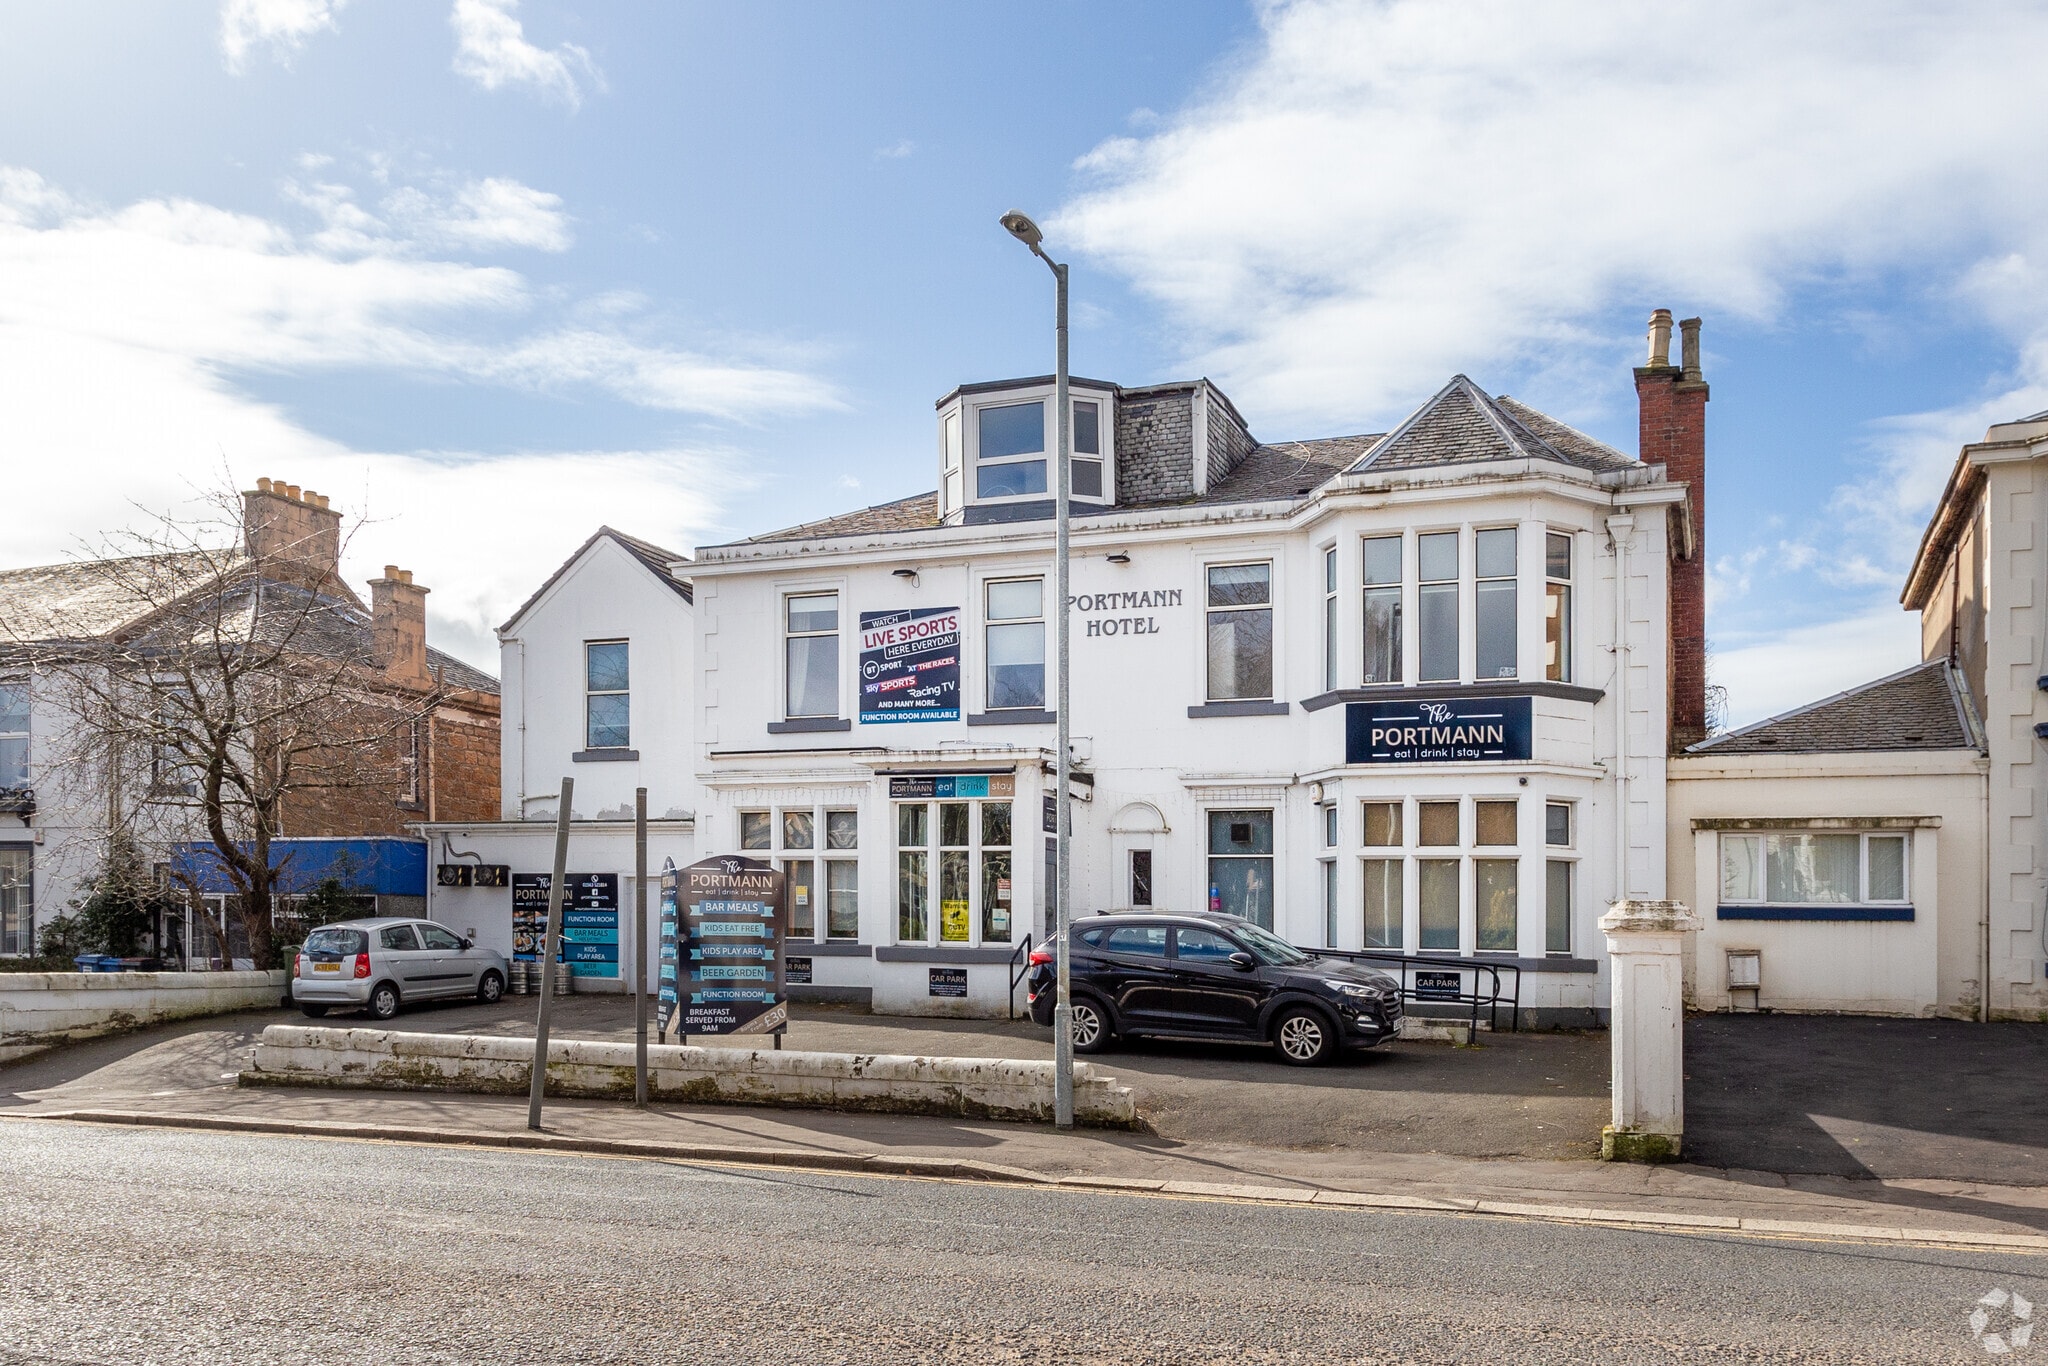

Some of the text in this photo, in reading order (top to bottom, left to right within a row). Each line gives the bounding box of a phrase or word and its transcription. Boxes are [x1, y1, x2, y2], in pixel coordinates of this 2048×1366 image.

[872, 616, 898, 628] WATCH
[1087, 617, 1160, 637] HOTEL
[864, 616, 957, 649] LIVE SPORTS
[888, 634, 954, 656] HERE EVERYDAY
[866, 660, 902, 675] BT SPORT
[907, 657, 955, 672] AT THE RACES
[866, 676, 916, 693] sky SPORTS
[907, 681, 955, 698] Racing TV
[921, 711, 957, 719] AVAILABLE
[1420, 704, 1454, 724] The
[1372, 725, 1503, 746] PORTMANN
[1394, 748, 1479, 758] eat drink stay
[938, 780, 952, 791] eat
[960, 781, 985, 791] drink
[992, 781, 1012, 792] stay
[721, 860, 742, 874] The
[536, 877, 551, 888] The
[691, 874, 772, 888] PORTMANN
[516, 890, 572, 900] PORTMN
[706, 903, 758, 912] BAR MEALS
[702, 969, 764, 977] BEER GARDEN
[1417, 979, 1434, 987] CAR
[765, 1008, 786, 1027] £30
